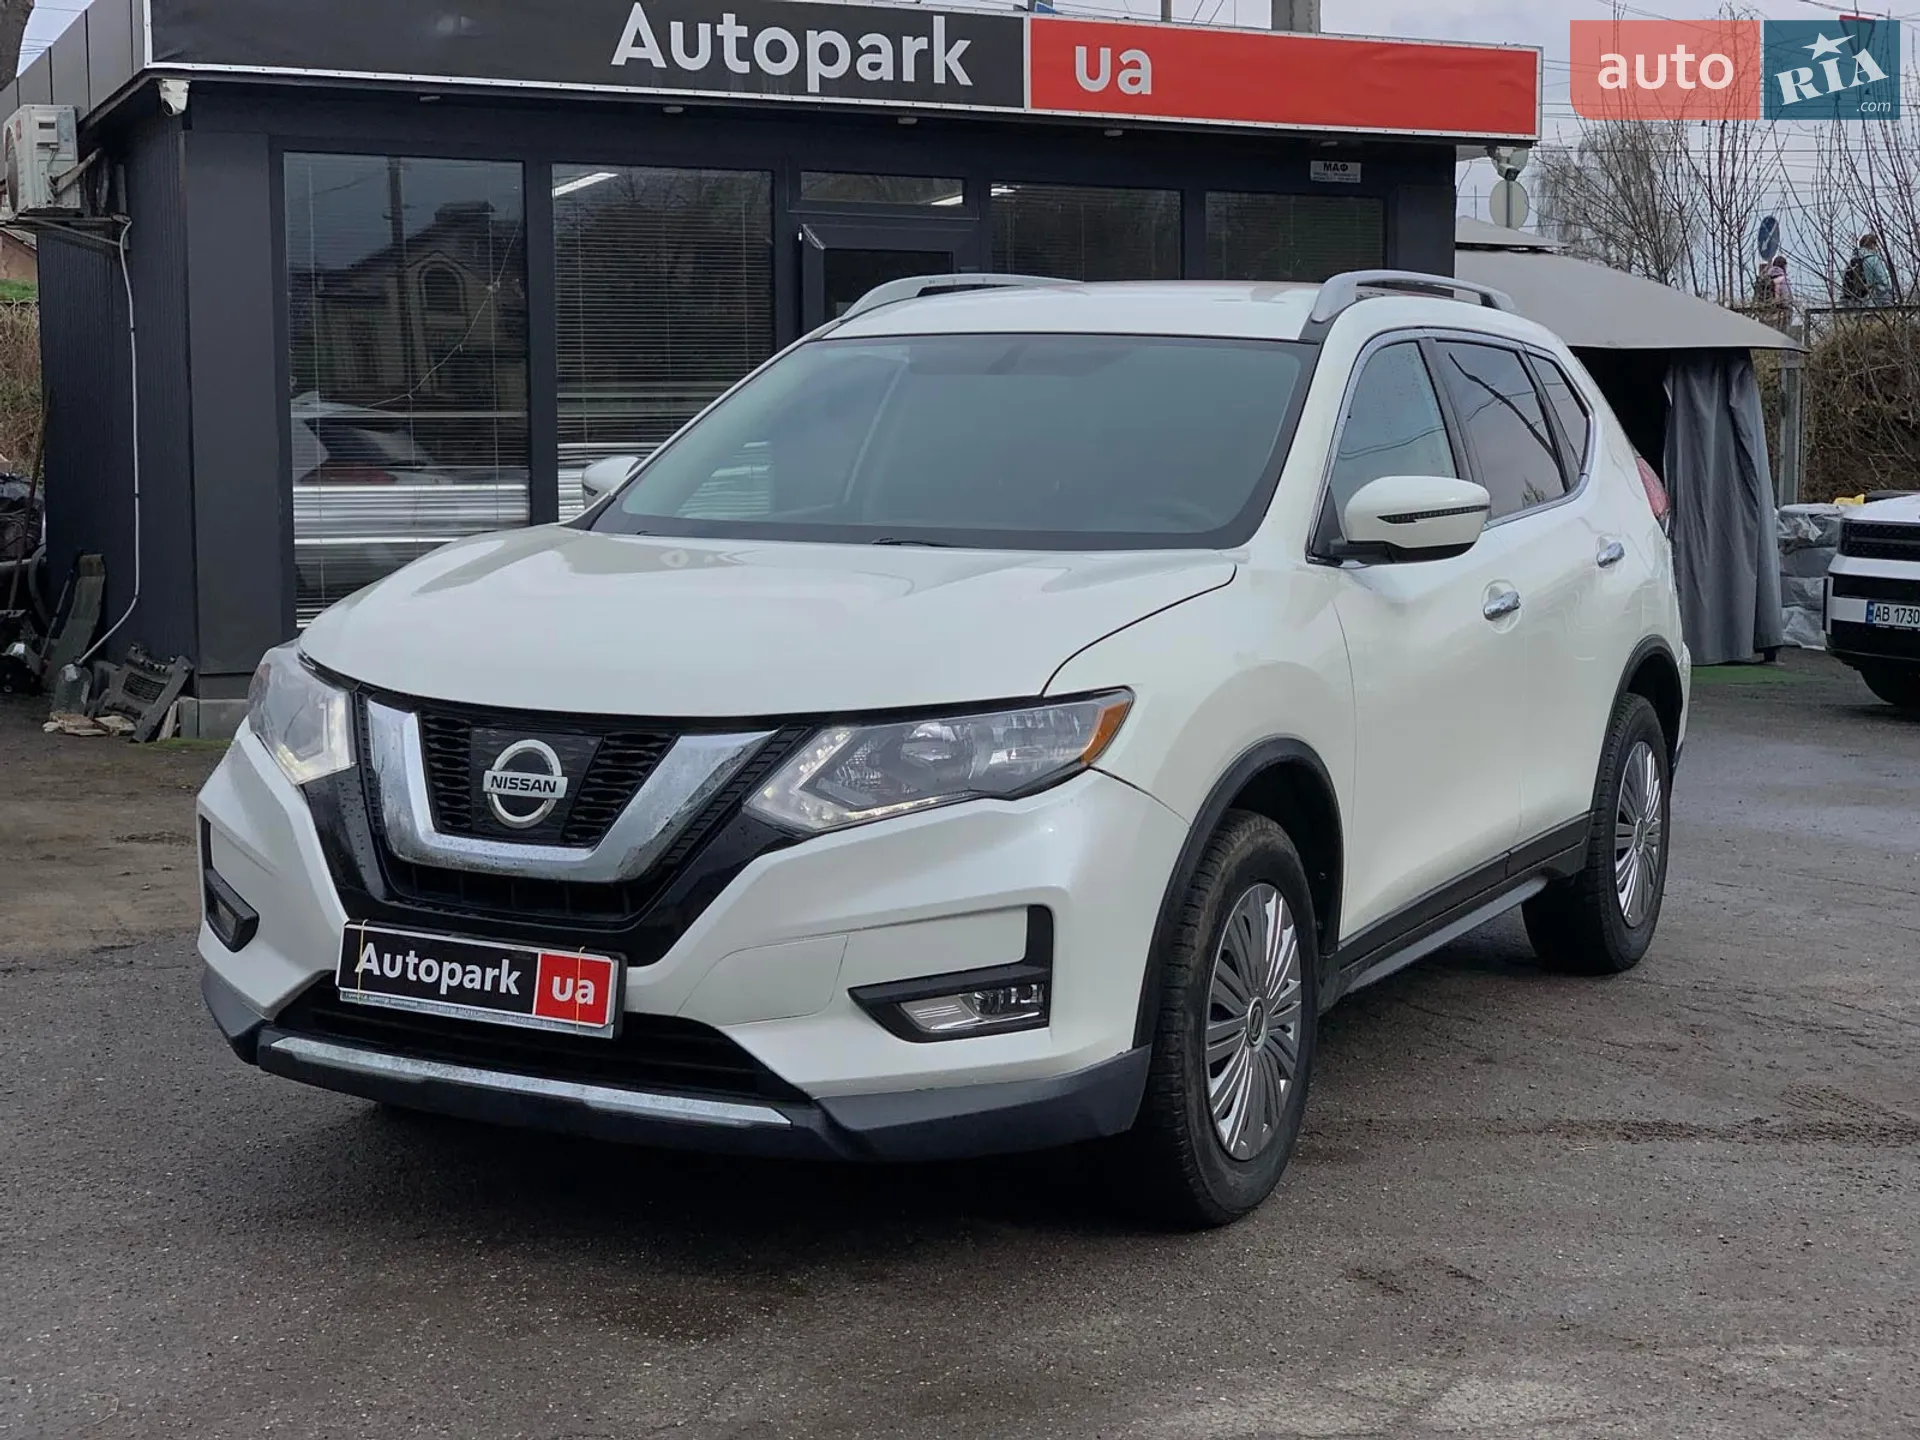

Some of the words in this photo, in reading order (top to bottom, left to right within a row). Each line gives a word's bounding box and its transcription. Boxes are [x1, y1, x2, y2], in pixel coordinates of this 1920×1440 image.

[610, 2, 973, 93] Autopark
[1074, 45, 1153, 95] ua
[1323, 162, 1349, 172] МАФ
[1874, 606, 1890, 622] AB
[1894, 608, 1920, 625] 1730
[490, 775, 557, 793] NISSAN
[355, 942, 519, 995] Autopark
[551, 975, 595, 1005] ua
